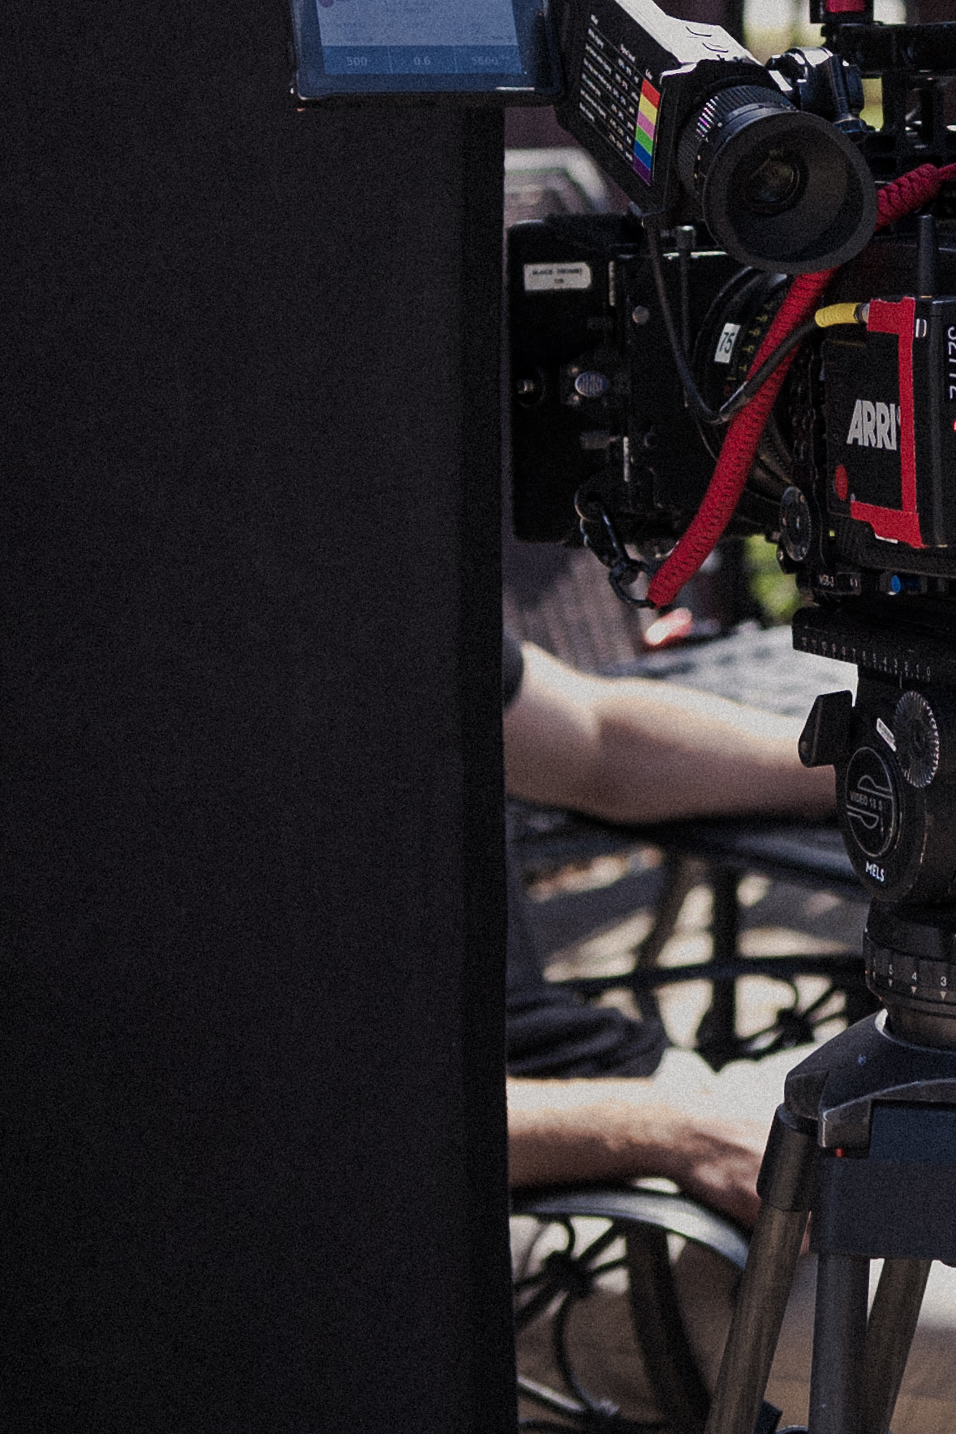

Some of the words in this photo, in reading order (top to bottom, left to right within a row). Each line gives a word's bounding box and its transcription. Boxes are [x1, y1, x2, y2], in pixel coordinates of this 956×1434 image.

[719, 332, 735, 354] 75
[846, 398, 898, 451] ARRI
[865, 860, 885, 882] MELS
